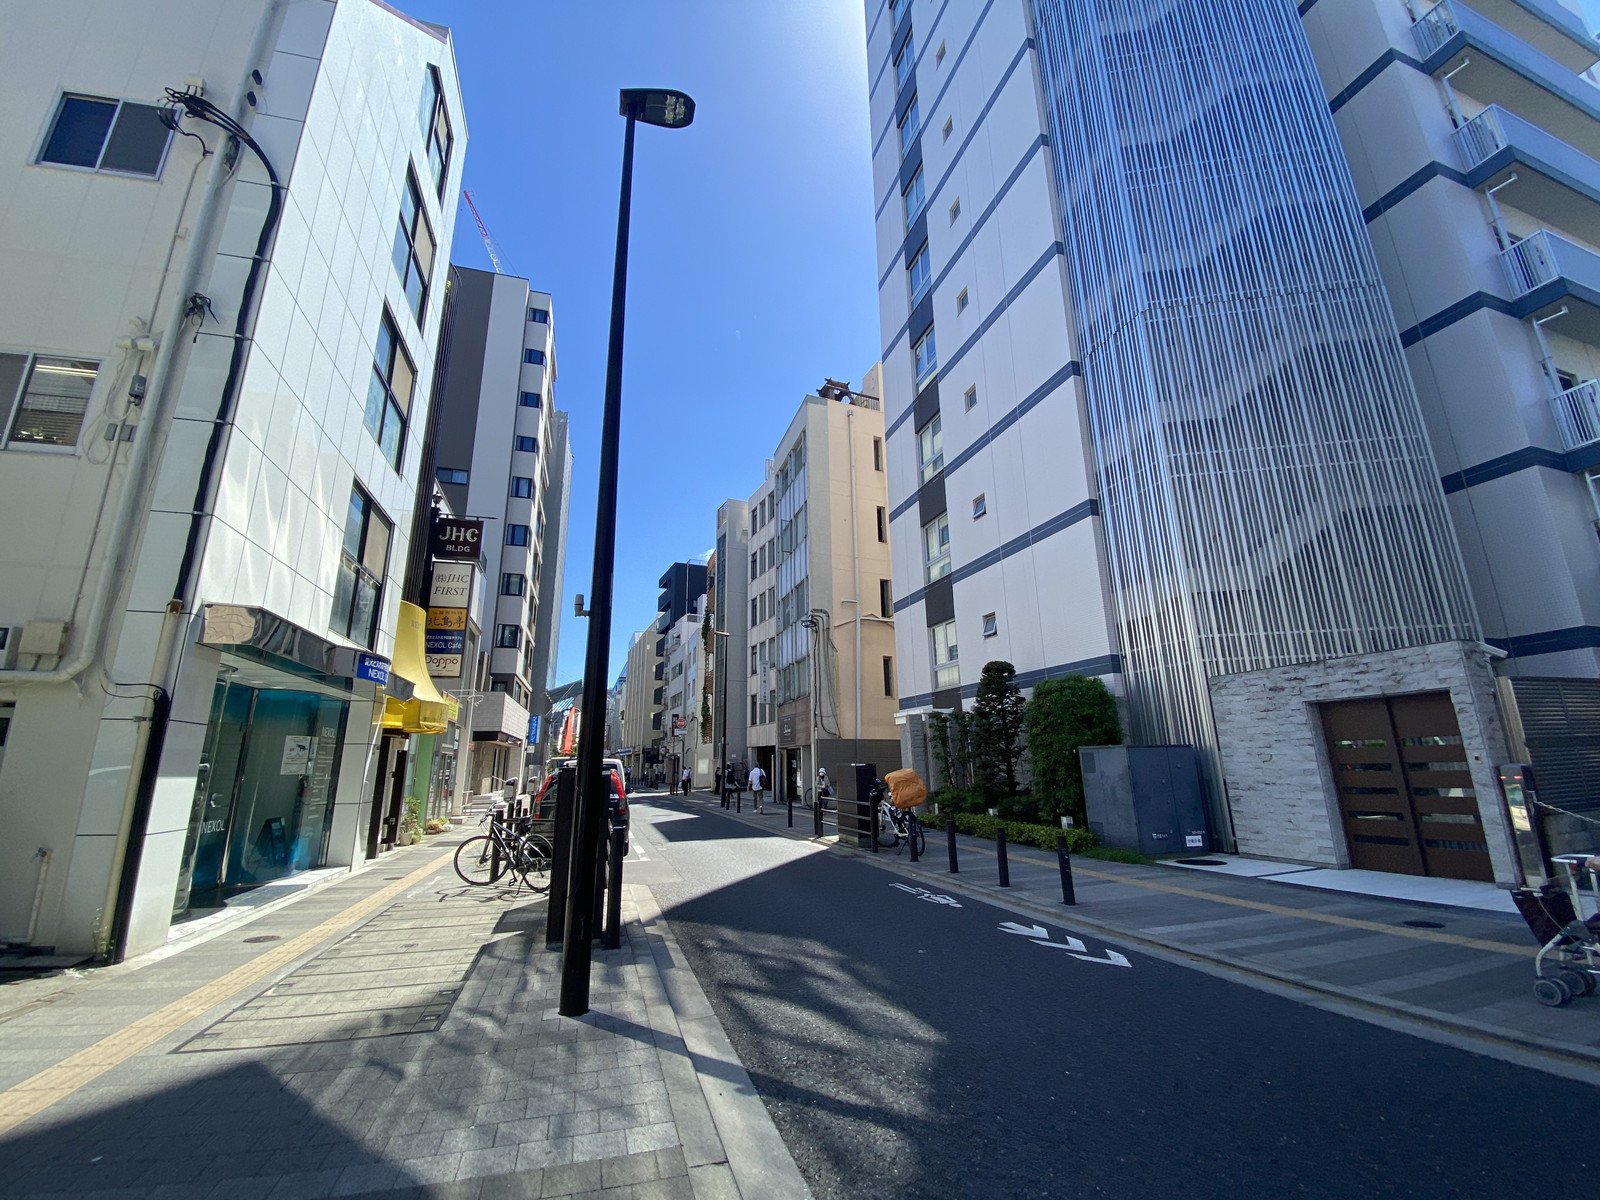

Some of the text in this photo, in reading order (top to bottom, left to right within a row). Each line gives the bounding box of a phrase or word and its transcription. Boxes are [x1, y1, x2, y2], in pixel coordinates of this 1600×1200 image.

[439, 526, 479, 542] JHC
[433, 586, 468, 596] FIRST
[426, 641, 462, 649] NEXOL Café
[425, 655, 459, 669] Doppo
[368, 668, 385, 681] NEXOL
[321, 727, 336, 738] NEXOL
[201, 819, 225, 834] NEXOL
